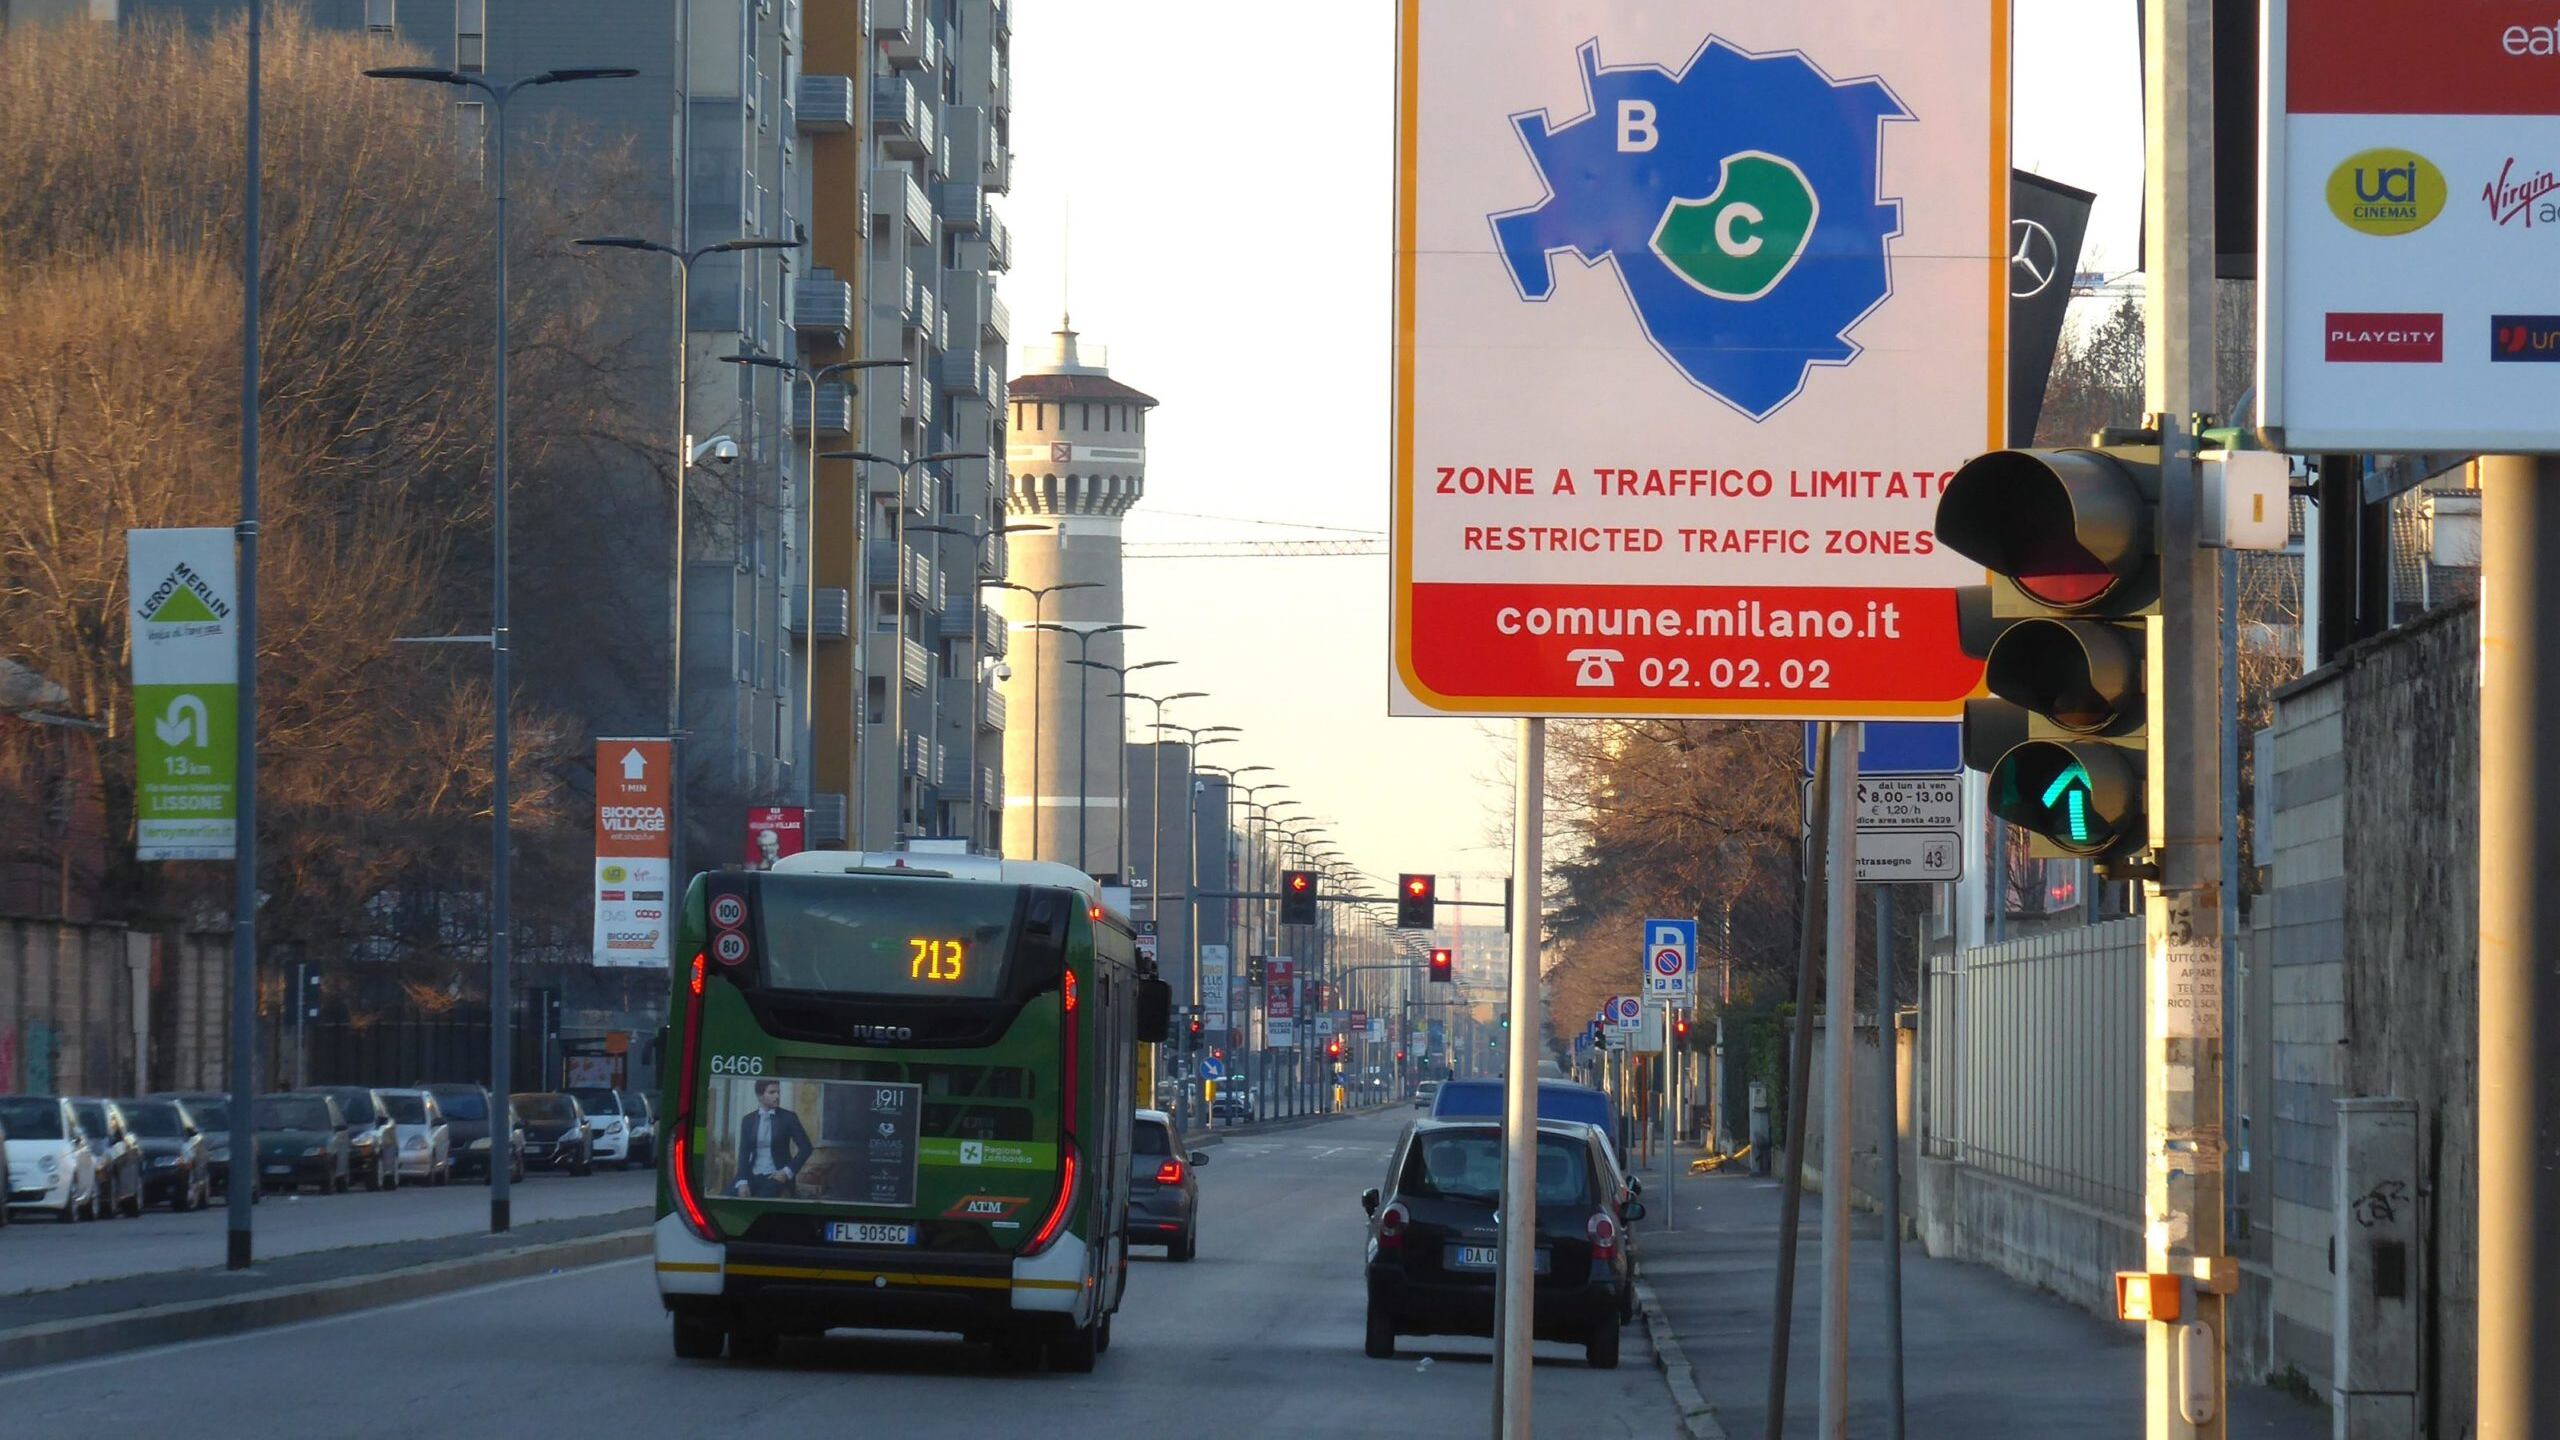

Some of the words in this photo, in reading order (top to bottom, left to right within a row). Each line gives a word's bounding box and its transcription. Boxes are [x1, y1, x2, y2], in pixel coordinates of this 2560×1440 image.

[1617, 99, 1659, 152] B
[2354, 161, 2416, 203] uci
[2481, 157, 2560, 228] Virgin
[2353, 206, 2417, 219] CINEMAS
[1714, 201, 1764, 259] C
[2331, 331, 2436, 343] PLAYCITY
[1436, 466, 1535, 496] ZONE
[1552, 468, 1576, 496] A
[1594, 468, 1774, 499] TRAFFICO
[1464, 526, 1664, 554] RESTRICTED
[1679, 528, 1810, 556] TRAFFIC
[1825, 530, 1936, 556] ZONES
[137, 572, 180, 621] LEROY
[174, 561, 231, 619] MERLIN
[1496, 599, 1901, 639] comune.milano.it
[1639, 657, 1831, 689] 02.02.02
[164, 755, 188, 776] 13
[628, 784, 648, 793] MIN
[1879, 781, 1894, 790] dal
[152, 796, 223, 811] LISSONE
[601, 806, 665, 819] BICOCCA
[602, 818, 666, 832] VILLAGE
[719, 904, 739, 919] 100
[723, 940, 740, 954] 80
[908, 938, 963, 981] 713
[853, 1024, 912, 1041] IVECO
[711, 1055, 763, 1075] 6466
[876, 1089, 904, 1107] 1911
[967, 1200, 1002, 1214] ATM
[835, 1224, 853, 1240] FL
[860, 1225, 906, 1242] 903GC
[1466, 1248, 1482, 1262] DA
